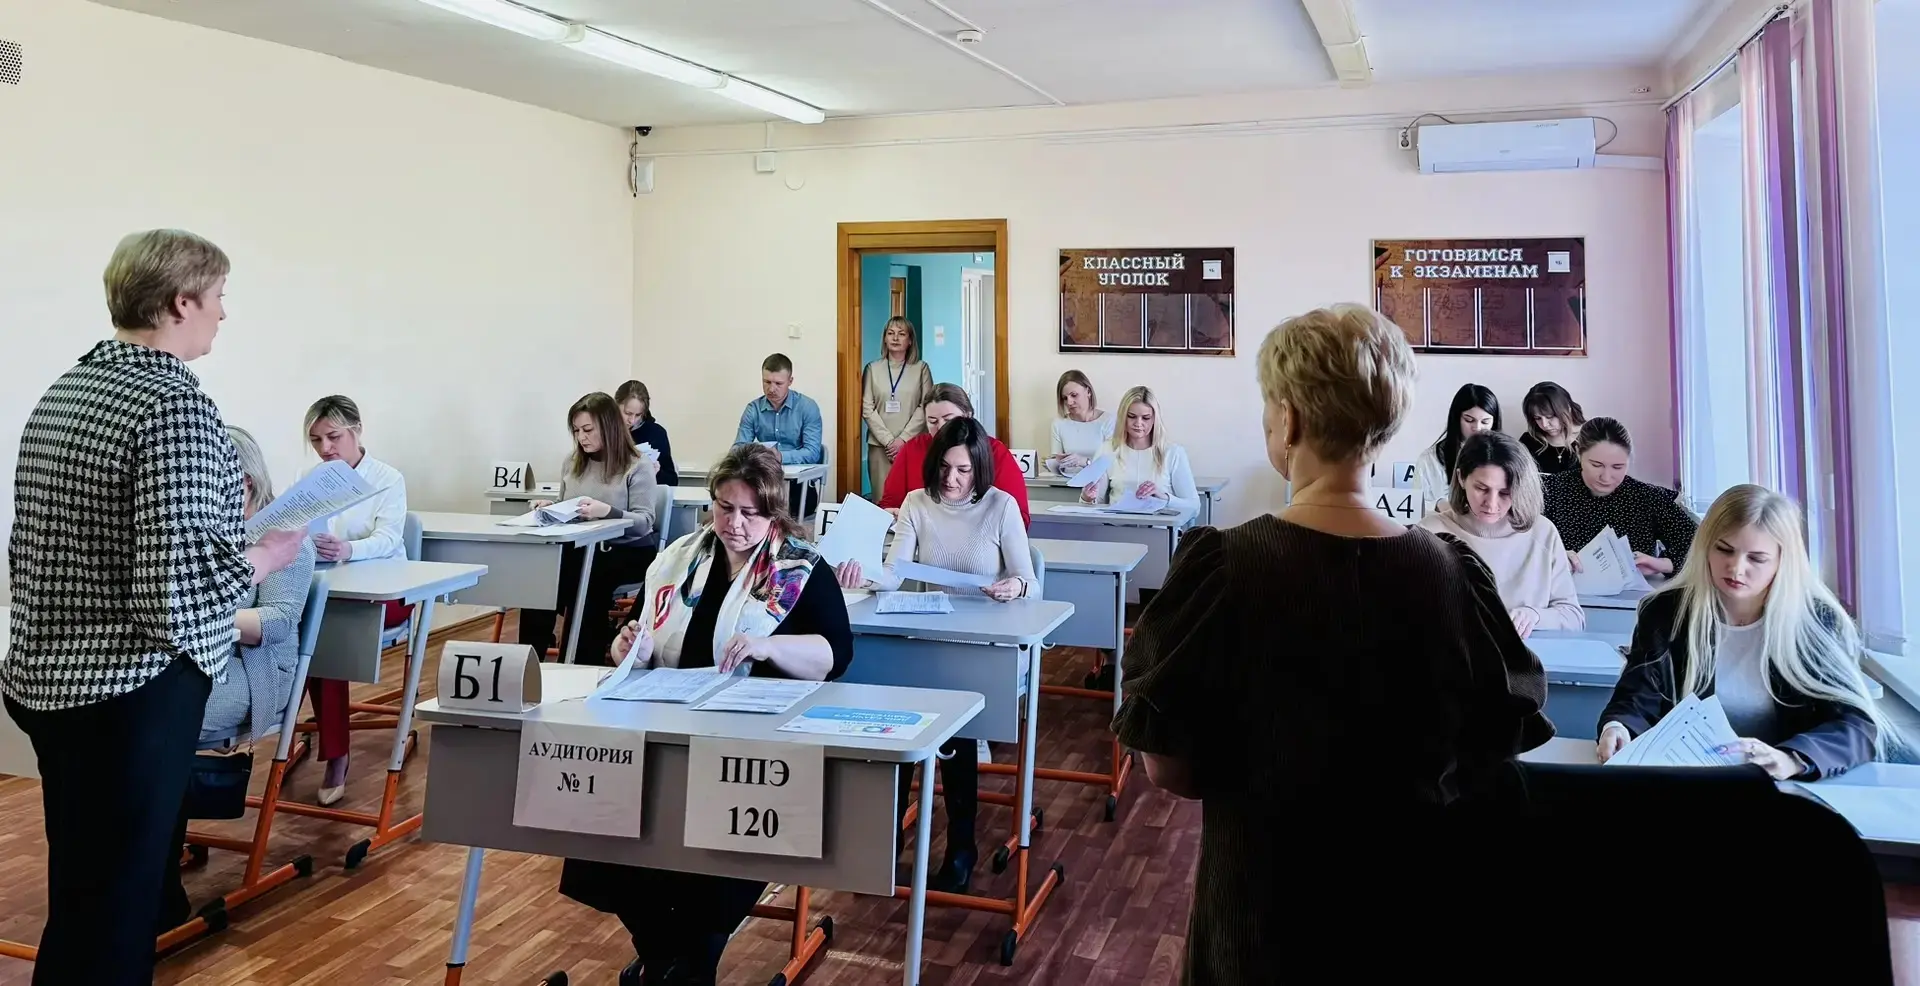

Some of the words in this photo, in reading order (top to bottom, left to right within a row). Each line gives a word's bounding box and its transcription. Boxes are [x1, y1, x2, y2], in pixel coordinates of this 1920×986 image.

[1083, 253, 1185, 270] КЛАССНЫЙ
[1404, 248, 1523, 263] ГОТОВИМСЯ
[1098, 273, 1170, 286] УГОЛОК
[1390, 265, 1404, 278] К
[1414, 264, 1539, 278] ЭКЗАМЕНАМ
[493, 466, 522, 488] В4
[1376, 493, 1415, 519] А4
[450, 654, 503, 702] Б1
[529, 742, 634, 765] АУДИТОРИЯ
[719, 755, 790, 787] ППЭ
[557, 771, 580, 793] №
[587, 775, 595, 795] 1
[728, 806, 779, 838] 120
